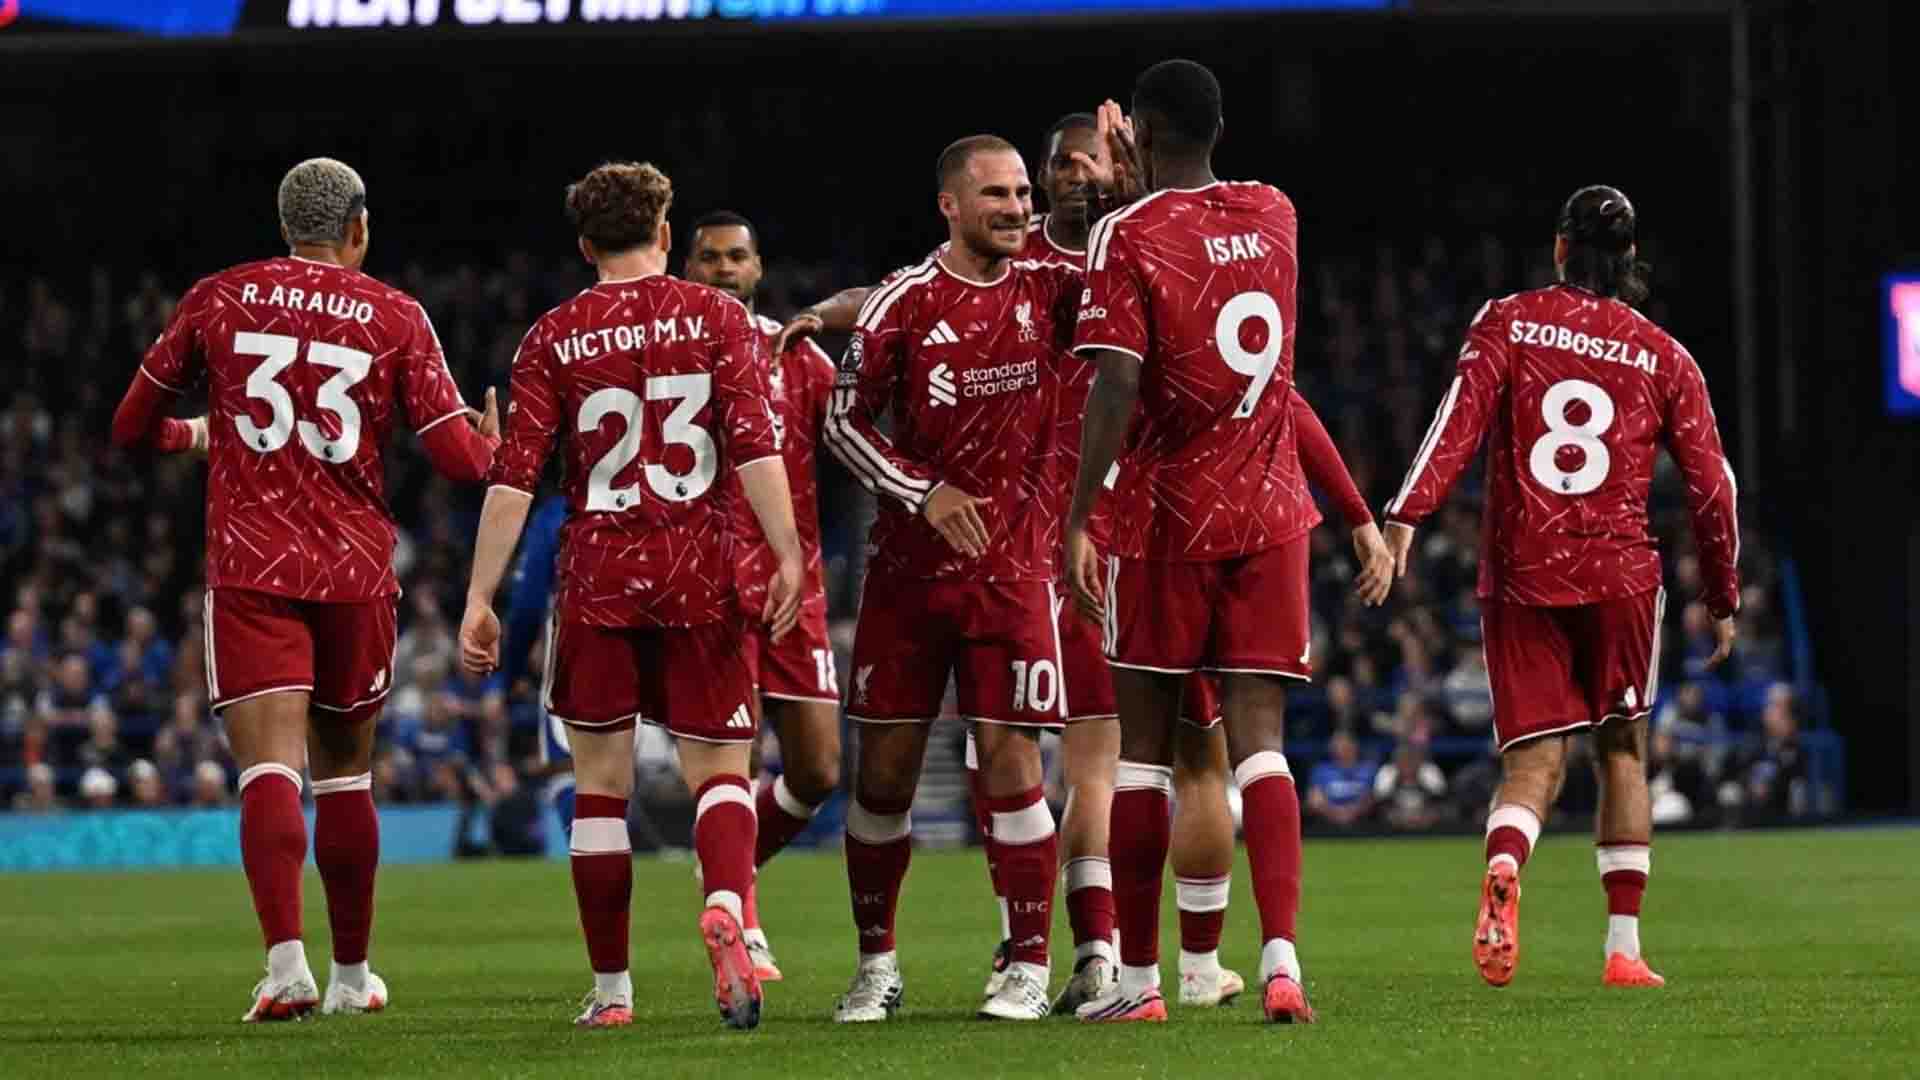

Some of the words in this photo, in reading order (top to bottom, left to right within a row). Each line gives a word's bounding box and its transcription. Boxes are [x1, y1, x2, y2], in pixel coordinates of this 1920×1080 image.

[1204, 234, 1265, 265] ISAK
[241, 282, 374, 324] R.ARAUJO
[653, 316, 710, 343] M.V.
[962, 357, 1037, 383] standard
[1215, 290, 1283, 419] 9
[1510, 320, 1658, 375] SZOBOSZLAI
[233, 331, 373, 464] 33
[577, 373, 717, 513] 23
[1529, 379, 1615, 496] 8
[1011, 659, 1058, 713] 10
[1013, 900, 1049, 914] LFC
